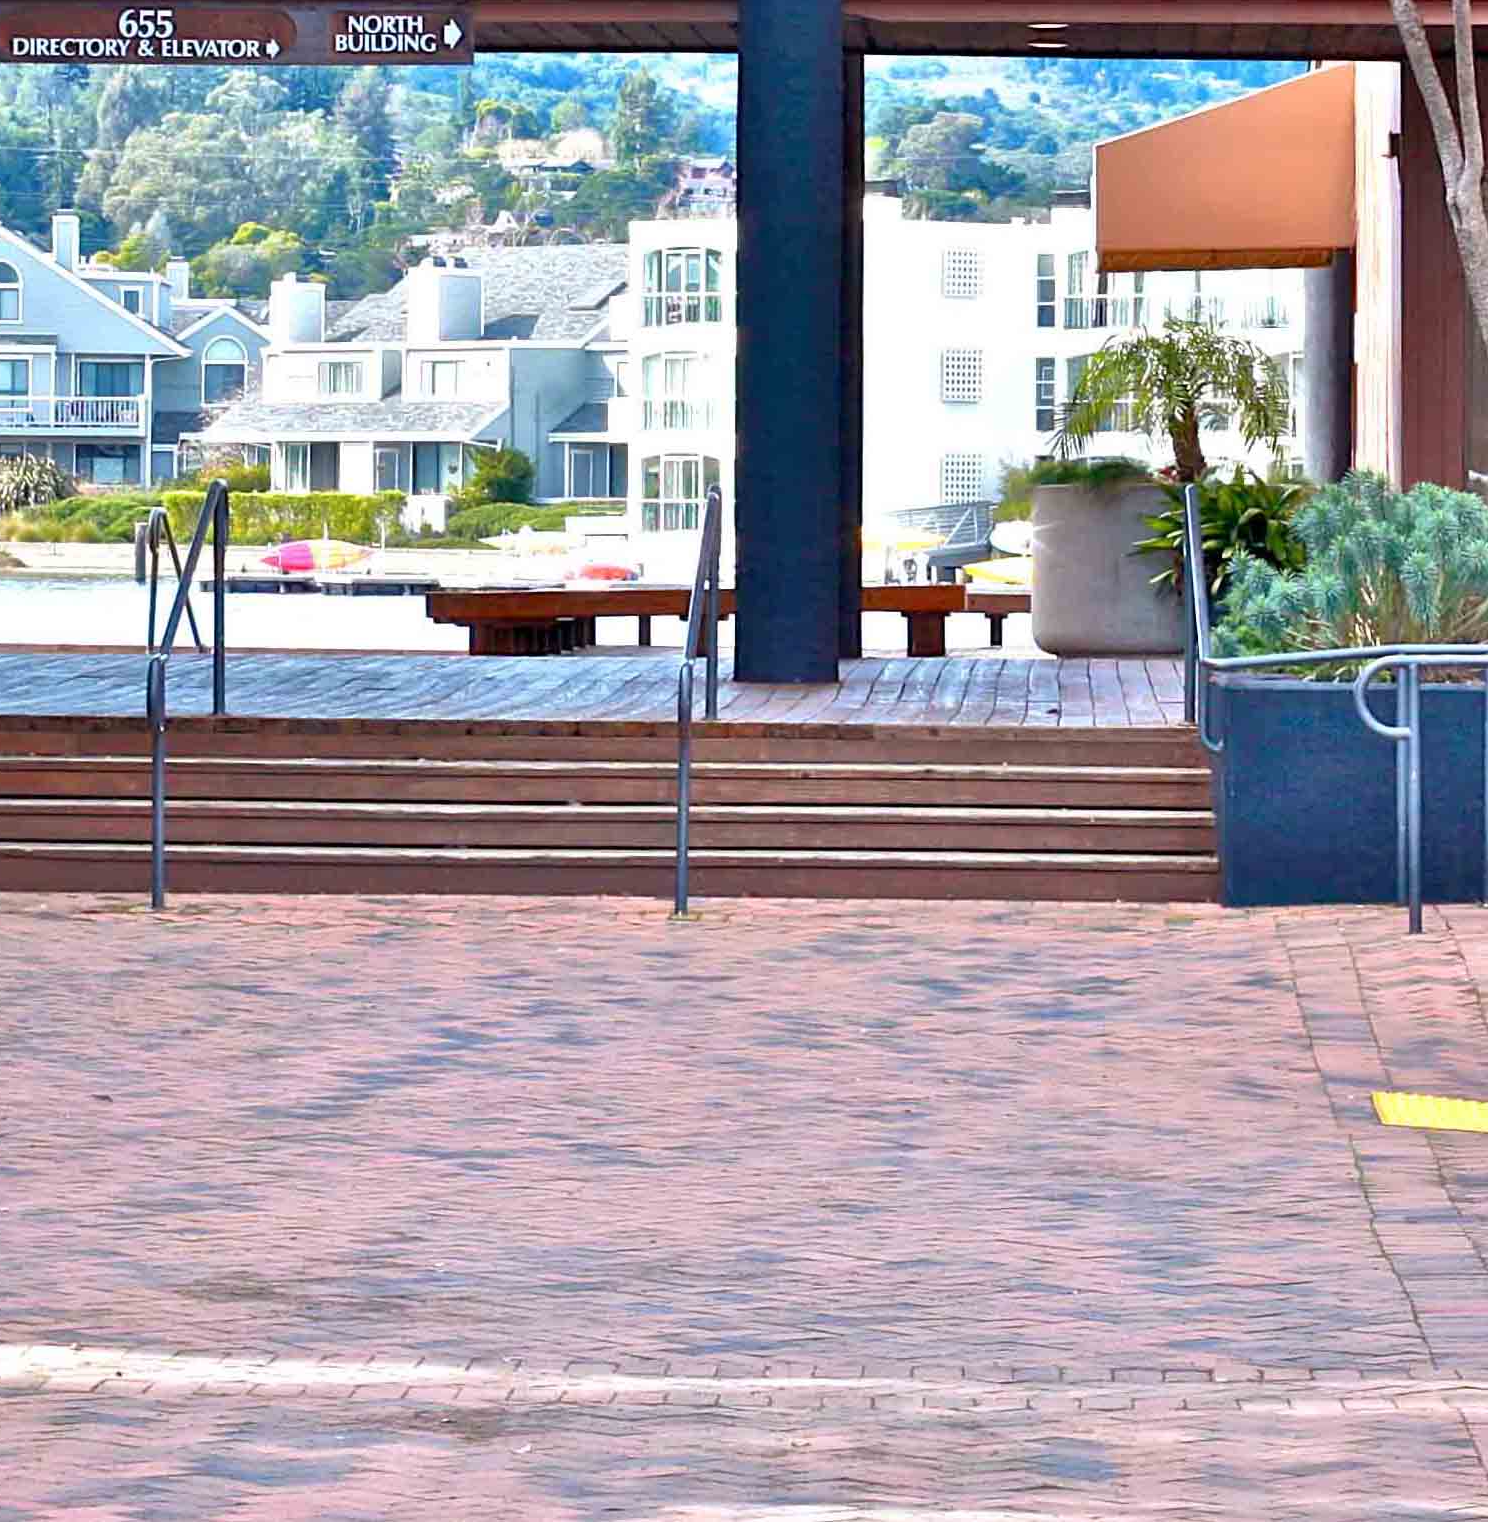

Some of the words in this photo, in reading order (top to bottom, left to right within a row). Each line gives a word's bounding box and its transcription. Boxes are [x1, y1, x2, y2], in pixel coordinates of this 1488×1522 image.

[118, 9, 173, 38] 655
[348, 15, 424, 34] NORTH
[13, 38, 130, 57] DIRECTORY
[137, 39, 155, 57] &
[162, 39, 261, 58] ELEVATOR
[335, 33, 437, 52] BUILDING
